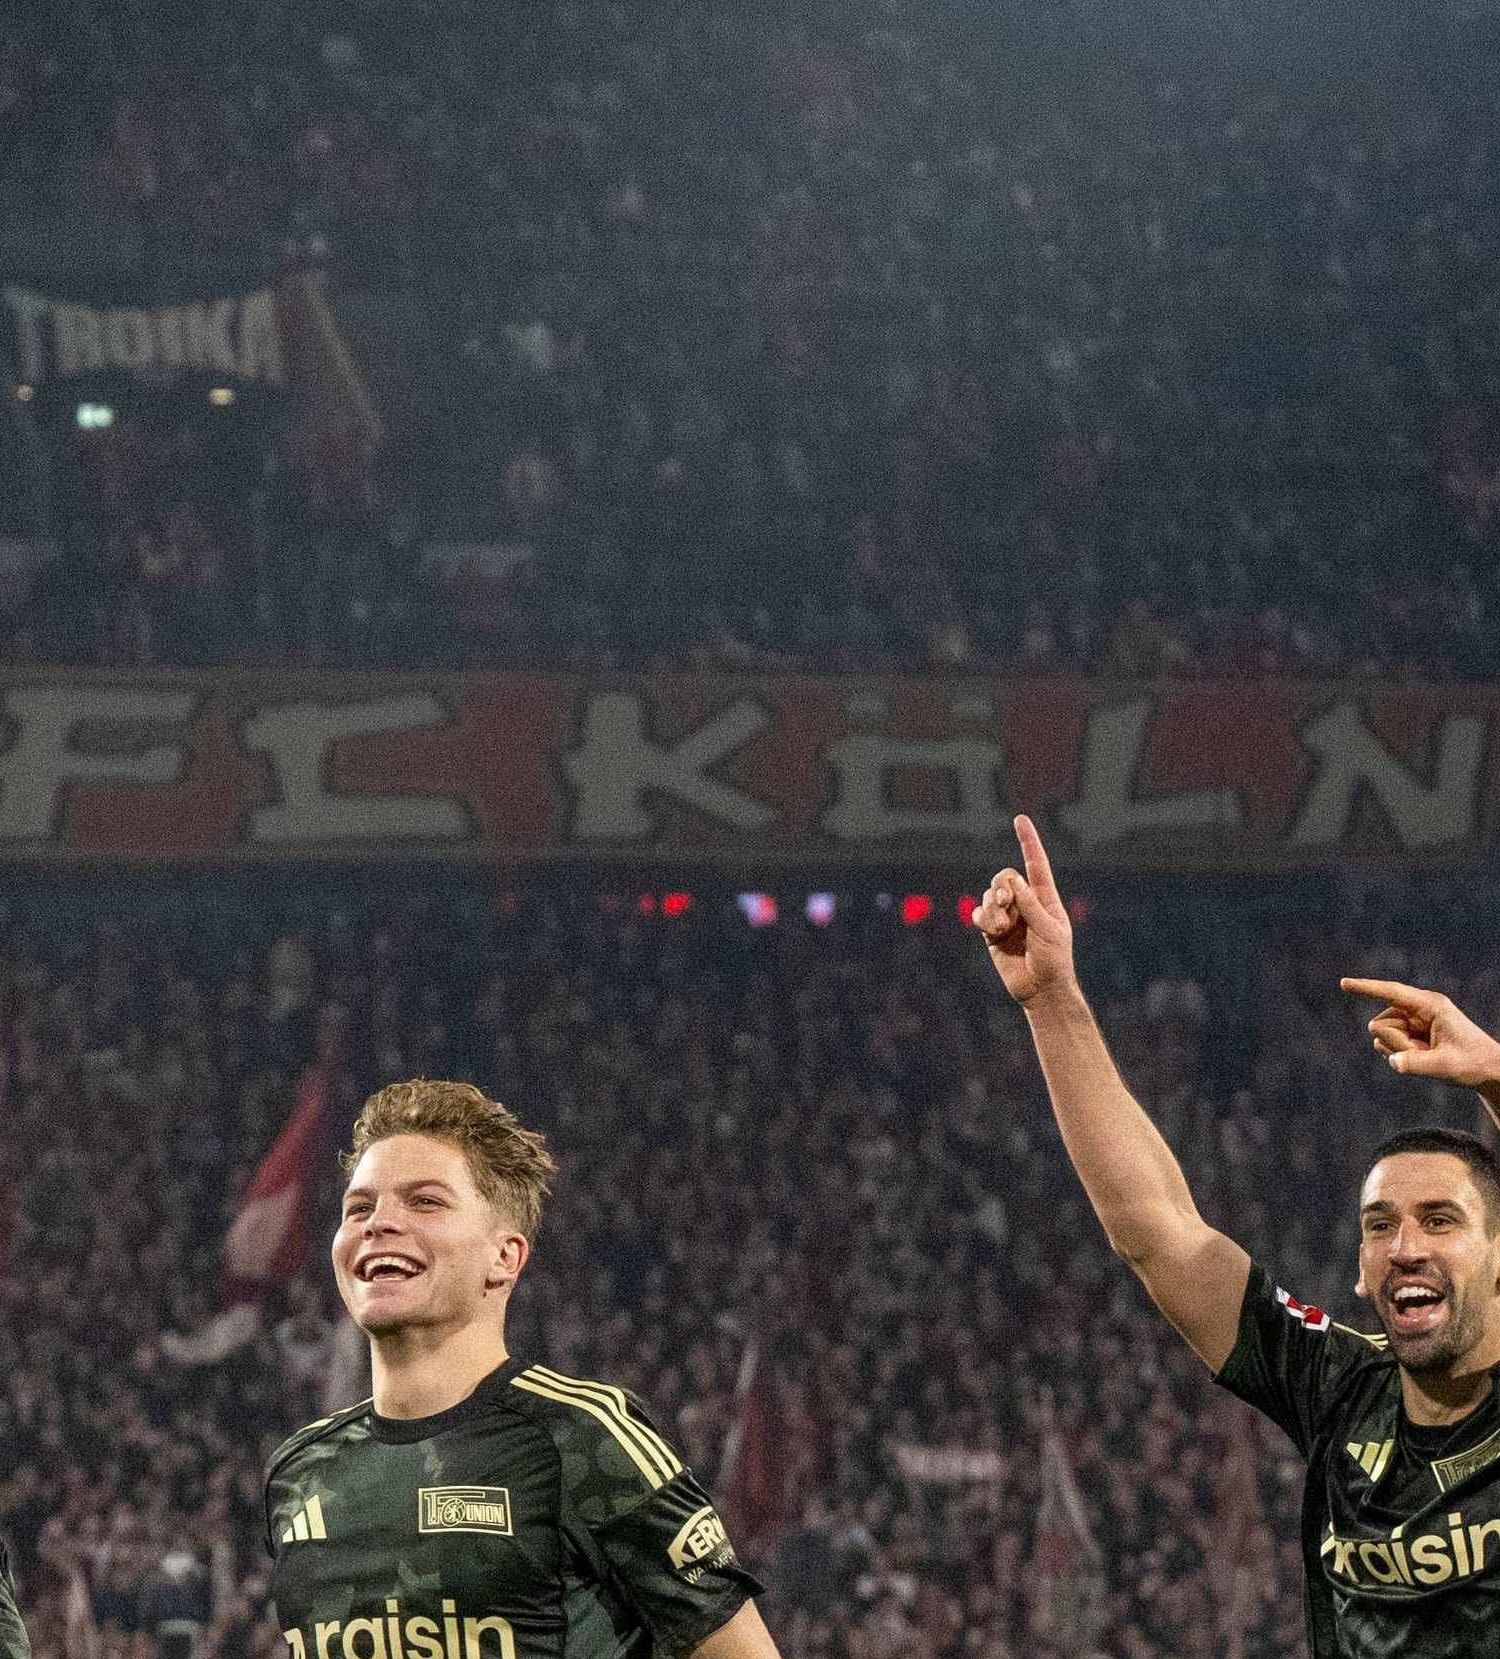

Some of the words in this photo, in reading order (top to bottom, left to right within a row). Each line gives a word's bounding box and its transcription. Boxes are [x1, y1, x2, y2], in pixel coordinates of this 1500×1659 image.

[2, 286, 286, 386] TROIKA
[566, 690, 1488, 848] KÖLN
[466, 1504, 504, 1524] UNION
